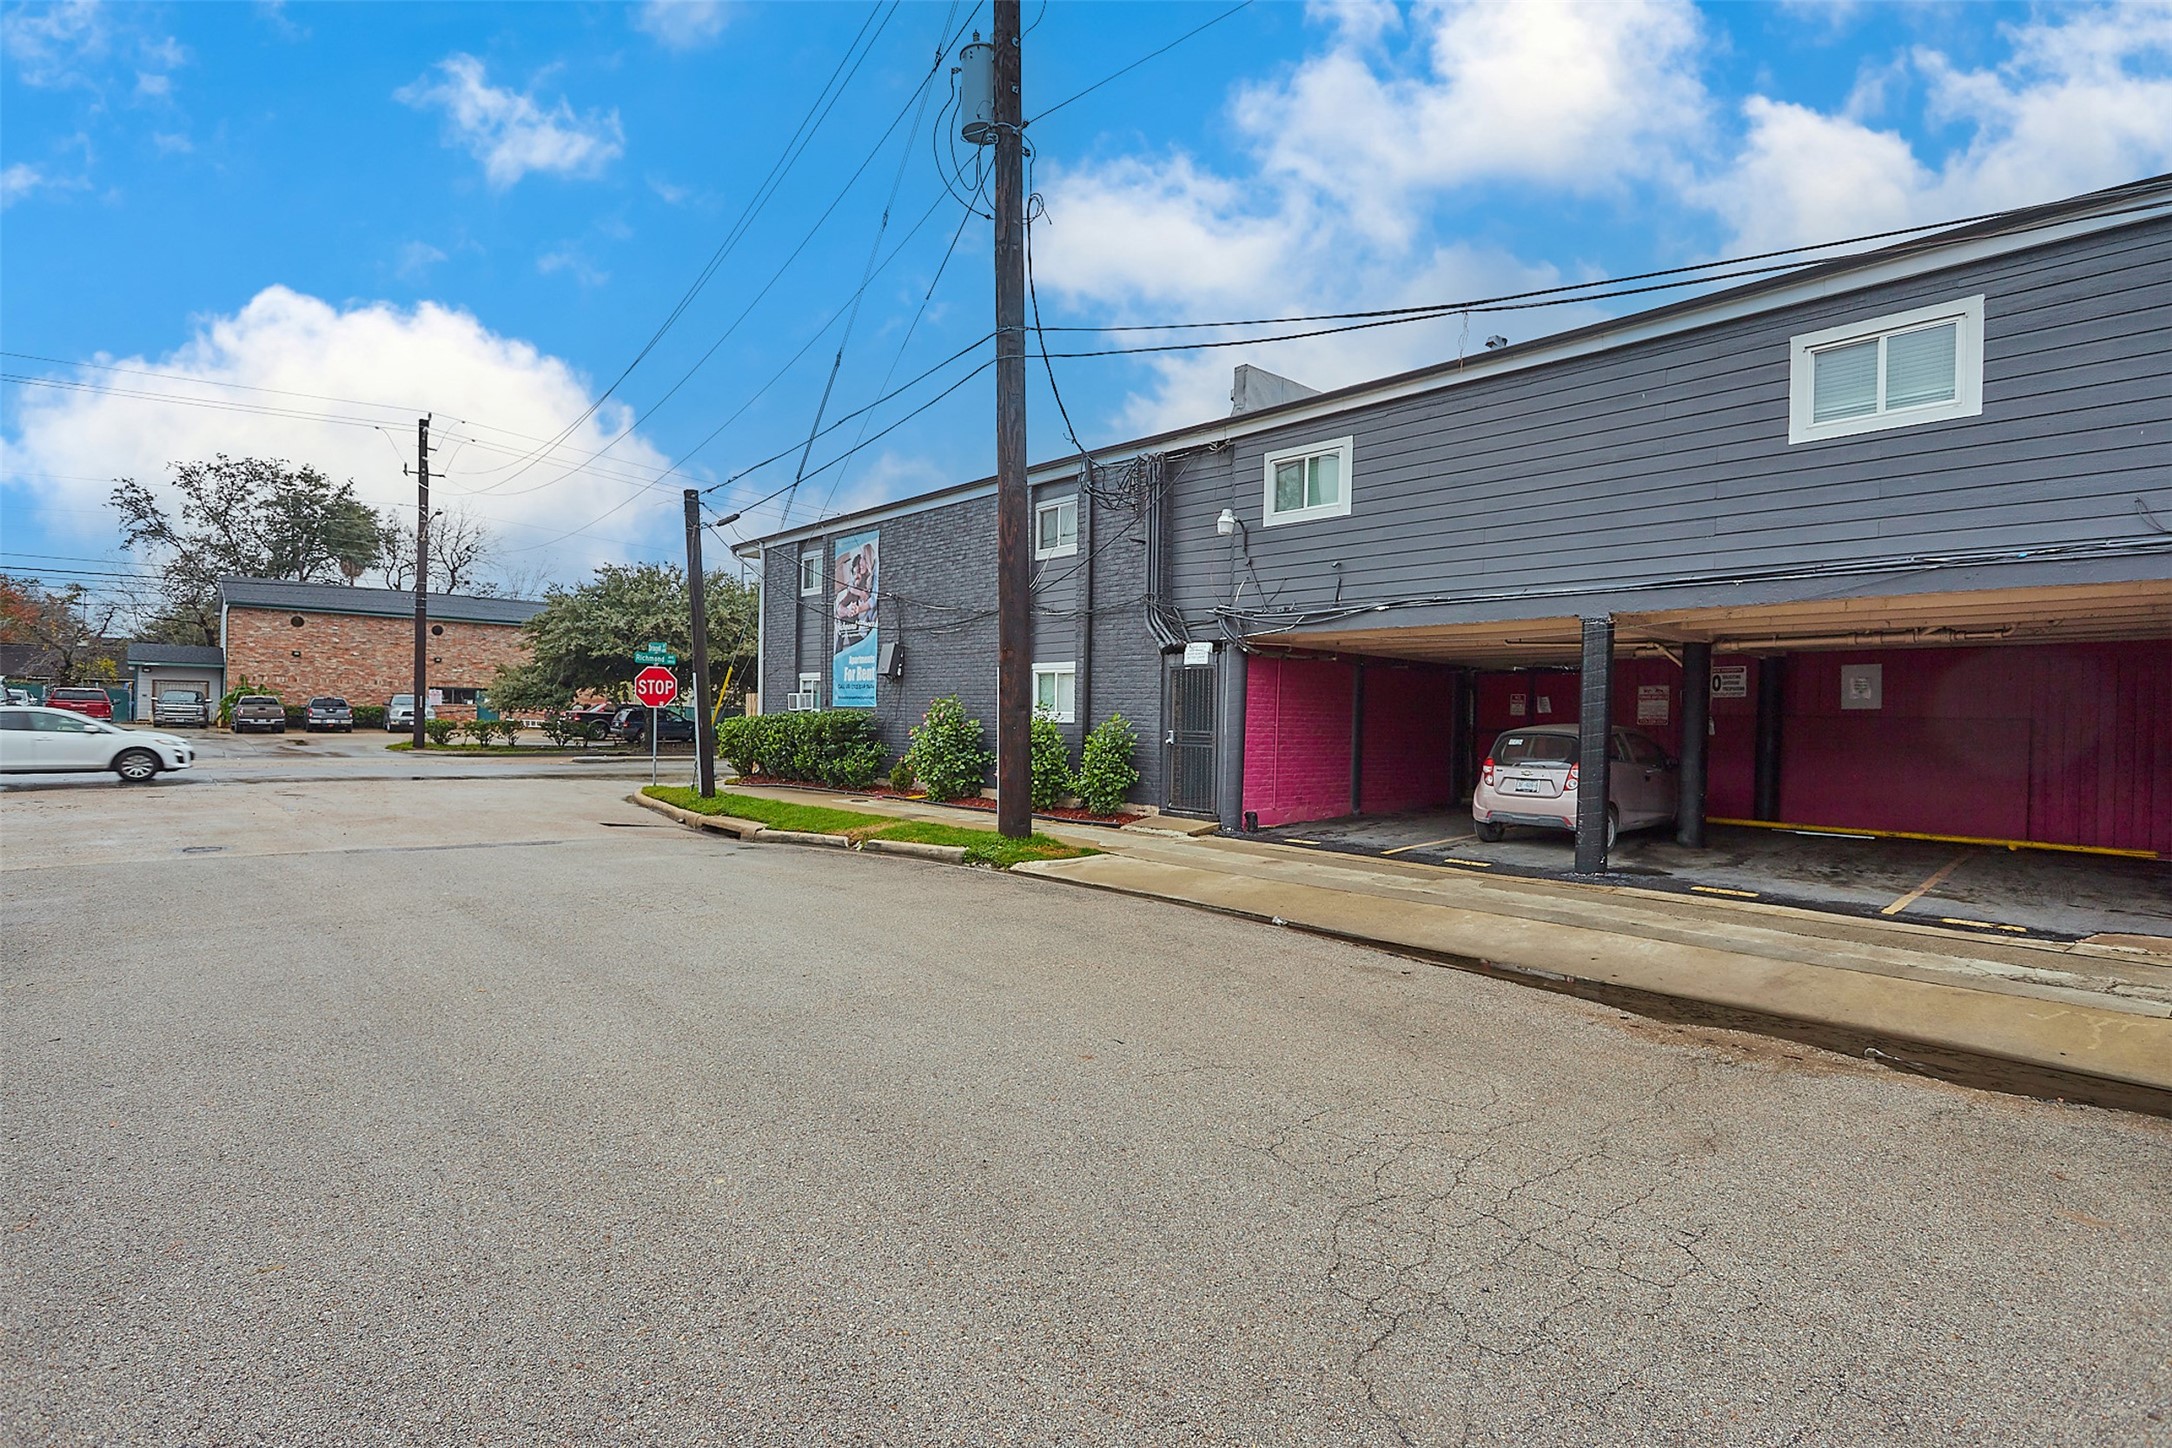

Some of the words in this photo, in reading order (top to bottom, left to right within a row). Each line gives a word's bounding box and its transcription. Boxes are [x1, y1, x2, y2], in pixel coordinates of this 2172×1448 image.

[635, 654, 665, 662] Richmond
[844, 667, 856, 681] For
[856, 666, 875, 681] Rent
[638, 680, 674, 694] STOP
